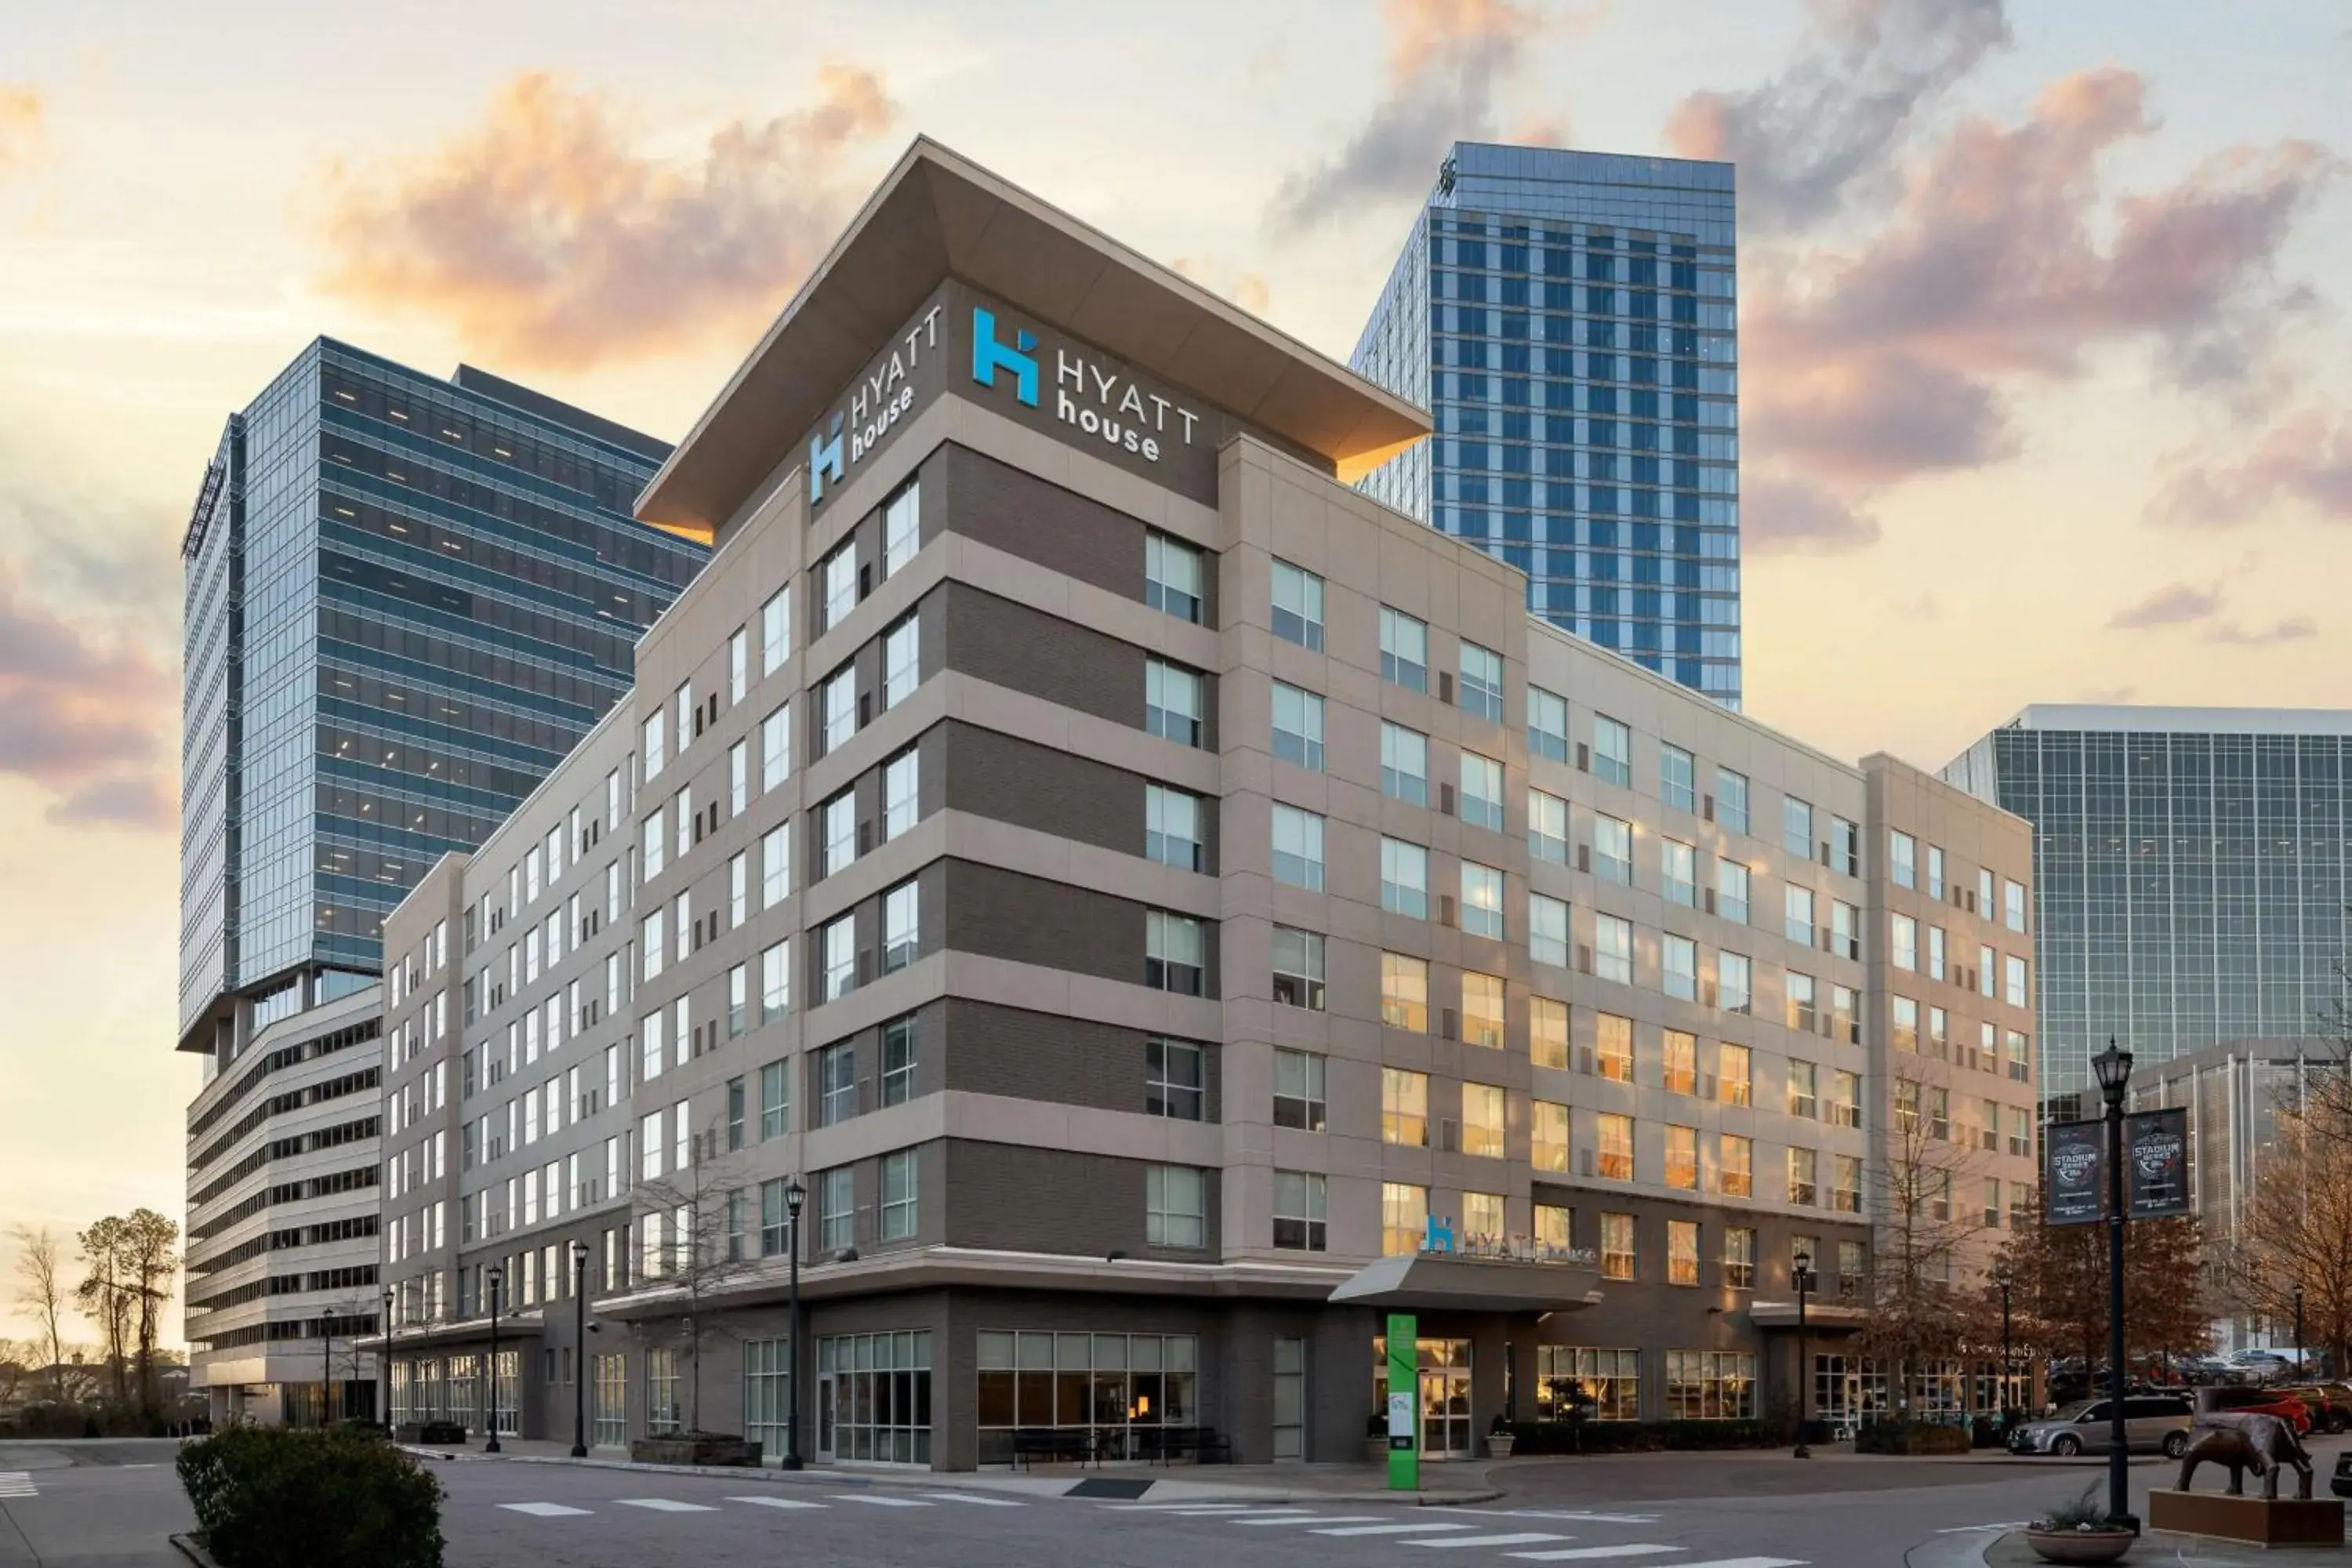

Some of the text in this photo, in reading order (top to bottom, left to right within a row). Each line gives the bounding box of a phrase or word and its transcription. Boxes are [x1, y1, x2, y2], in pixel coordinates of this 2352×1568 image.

[852, 305, 942, 430] HYATT
[1058, 349, 1200, 445] HYATT
[852, 386, 916, 464] house
[1058, 389, 1161, 462] house
[2053, 1152, 2096, 1167] STADIUM
[2134, 1142, 2180, 1157] STADIUM
